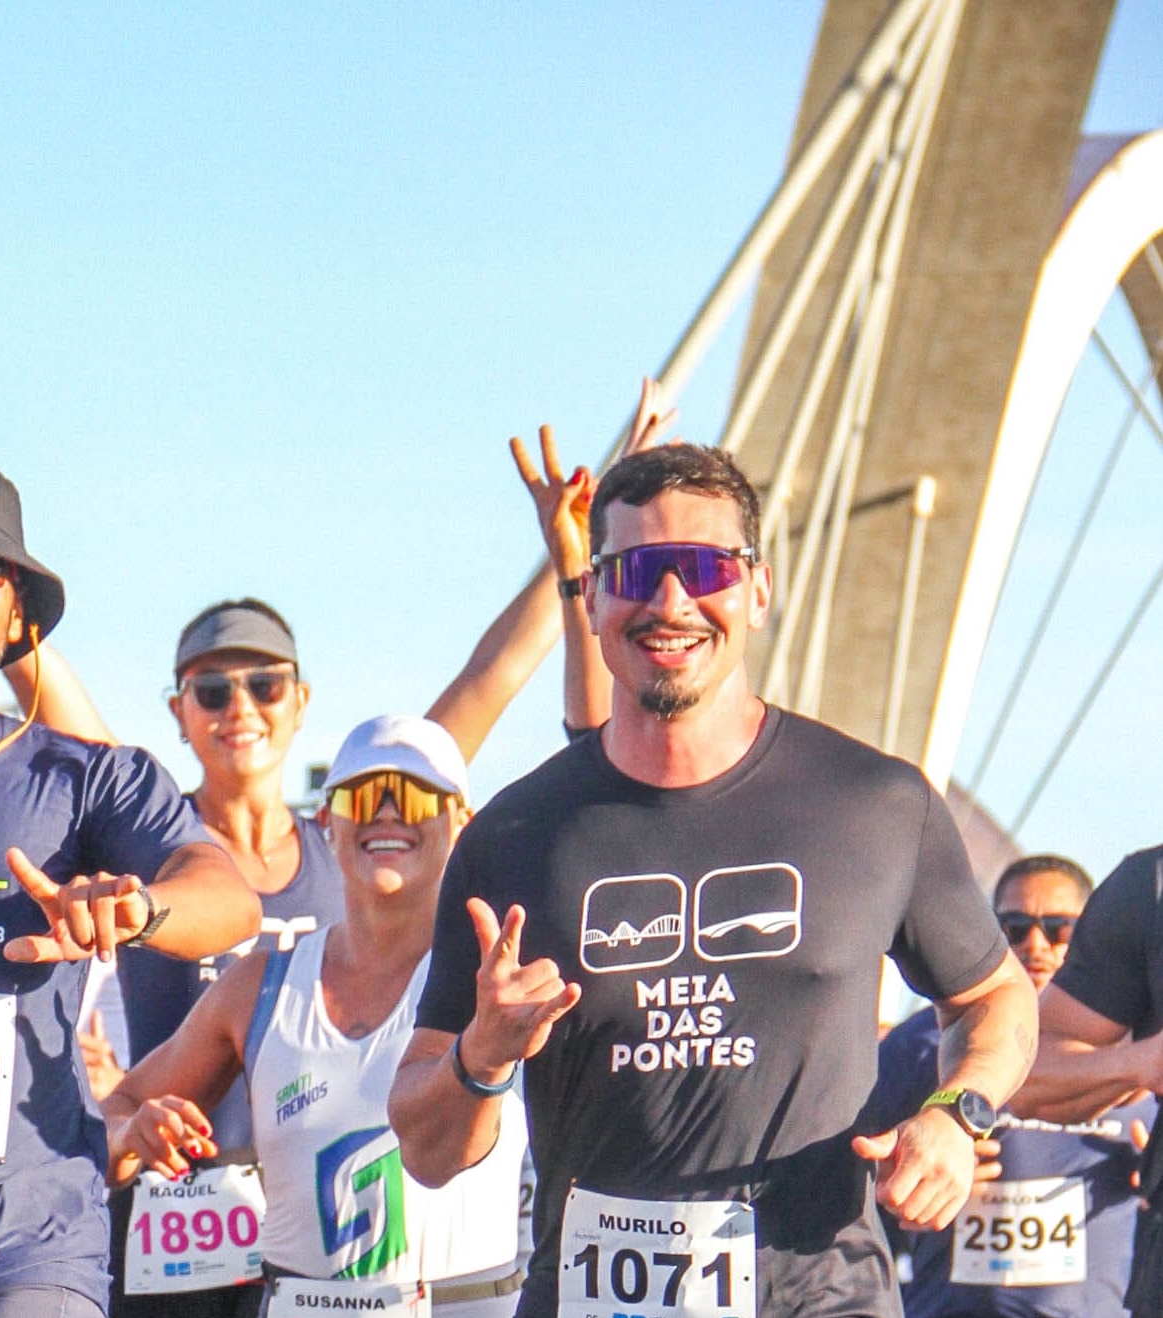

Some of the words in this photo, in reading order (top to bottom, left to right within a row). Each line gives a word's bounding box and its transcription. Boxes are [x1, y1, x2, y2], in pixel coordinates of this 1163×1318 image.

[636, 972, 736, 1009] MEIA
[647, 1005, 723, 1040] DAS
[611, 1036, 756, 1073] PONTES
[276, 1080, 327, 1126] TREINOS
[149, 1184, 218, 1199] RAQUEL
[134, 1205, 259, 1256] 1890
[599, 1213, 686, 1236] MURILO
[964, 1214, 1076, 1252] 2594
[573, 1243, 732, 1308] 1071
[295, 1294, 386, 1310] SUSANNA
